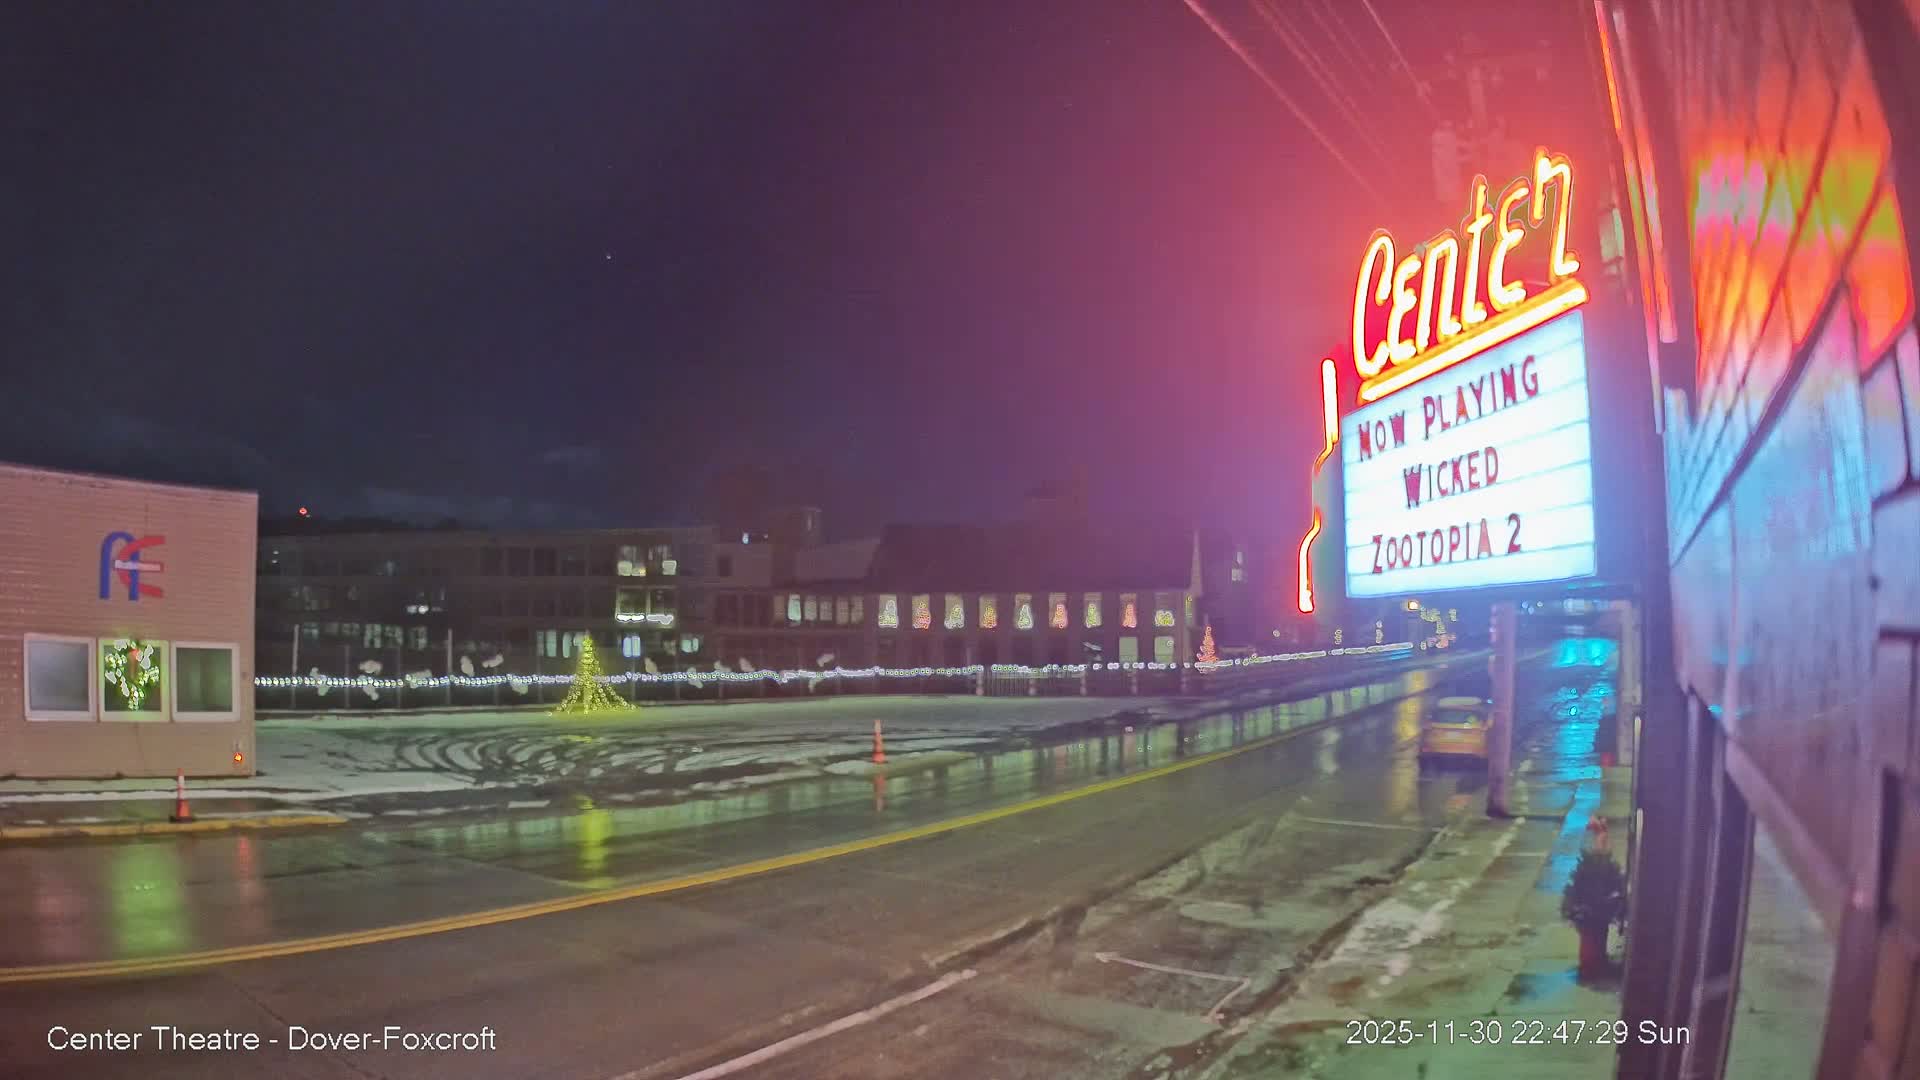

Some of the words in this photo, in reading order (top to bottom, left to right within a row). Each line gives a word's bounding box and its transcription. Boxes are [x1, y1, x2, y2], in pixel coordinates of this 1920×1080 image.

[1358, 412, 1406, 461] NOW
[1423, 354, 1540, 441] PLAYING
[1402, 446, 1500, 508] WICKED
[1371, 517, 1493, 574] ZOOTOPIA
[1507, 512, 1523, 554] 2
